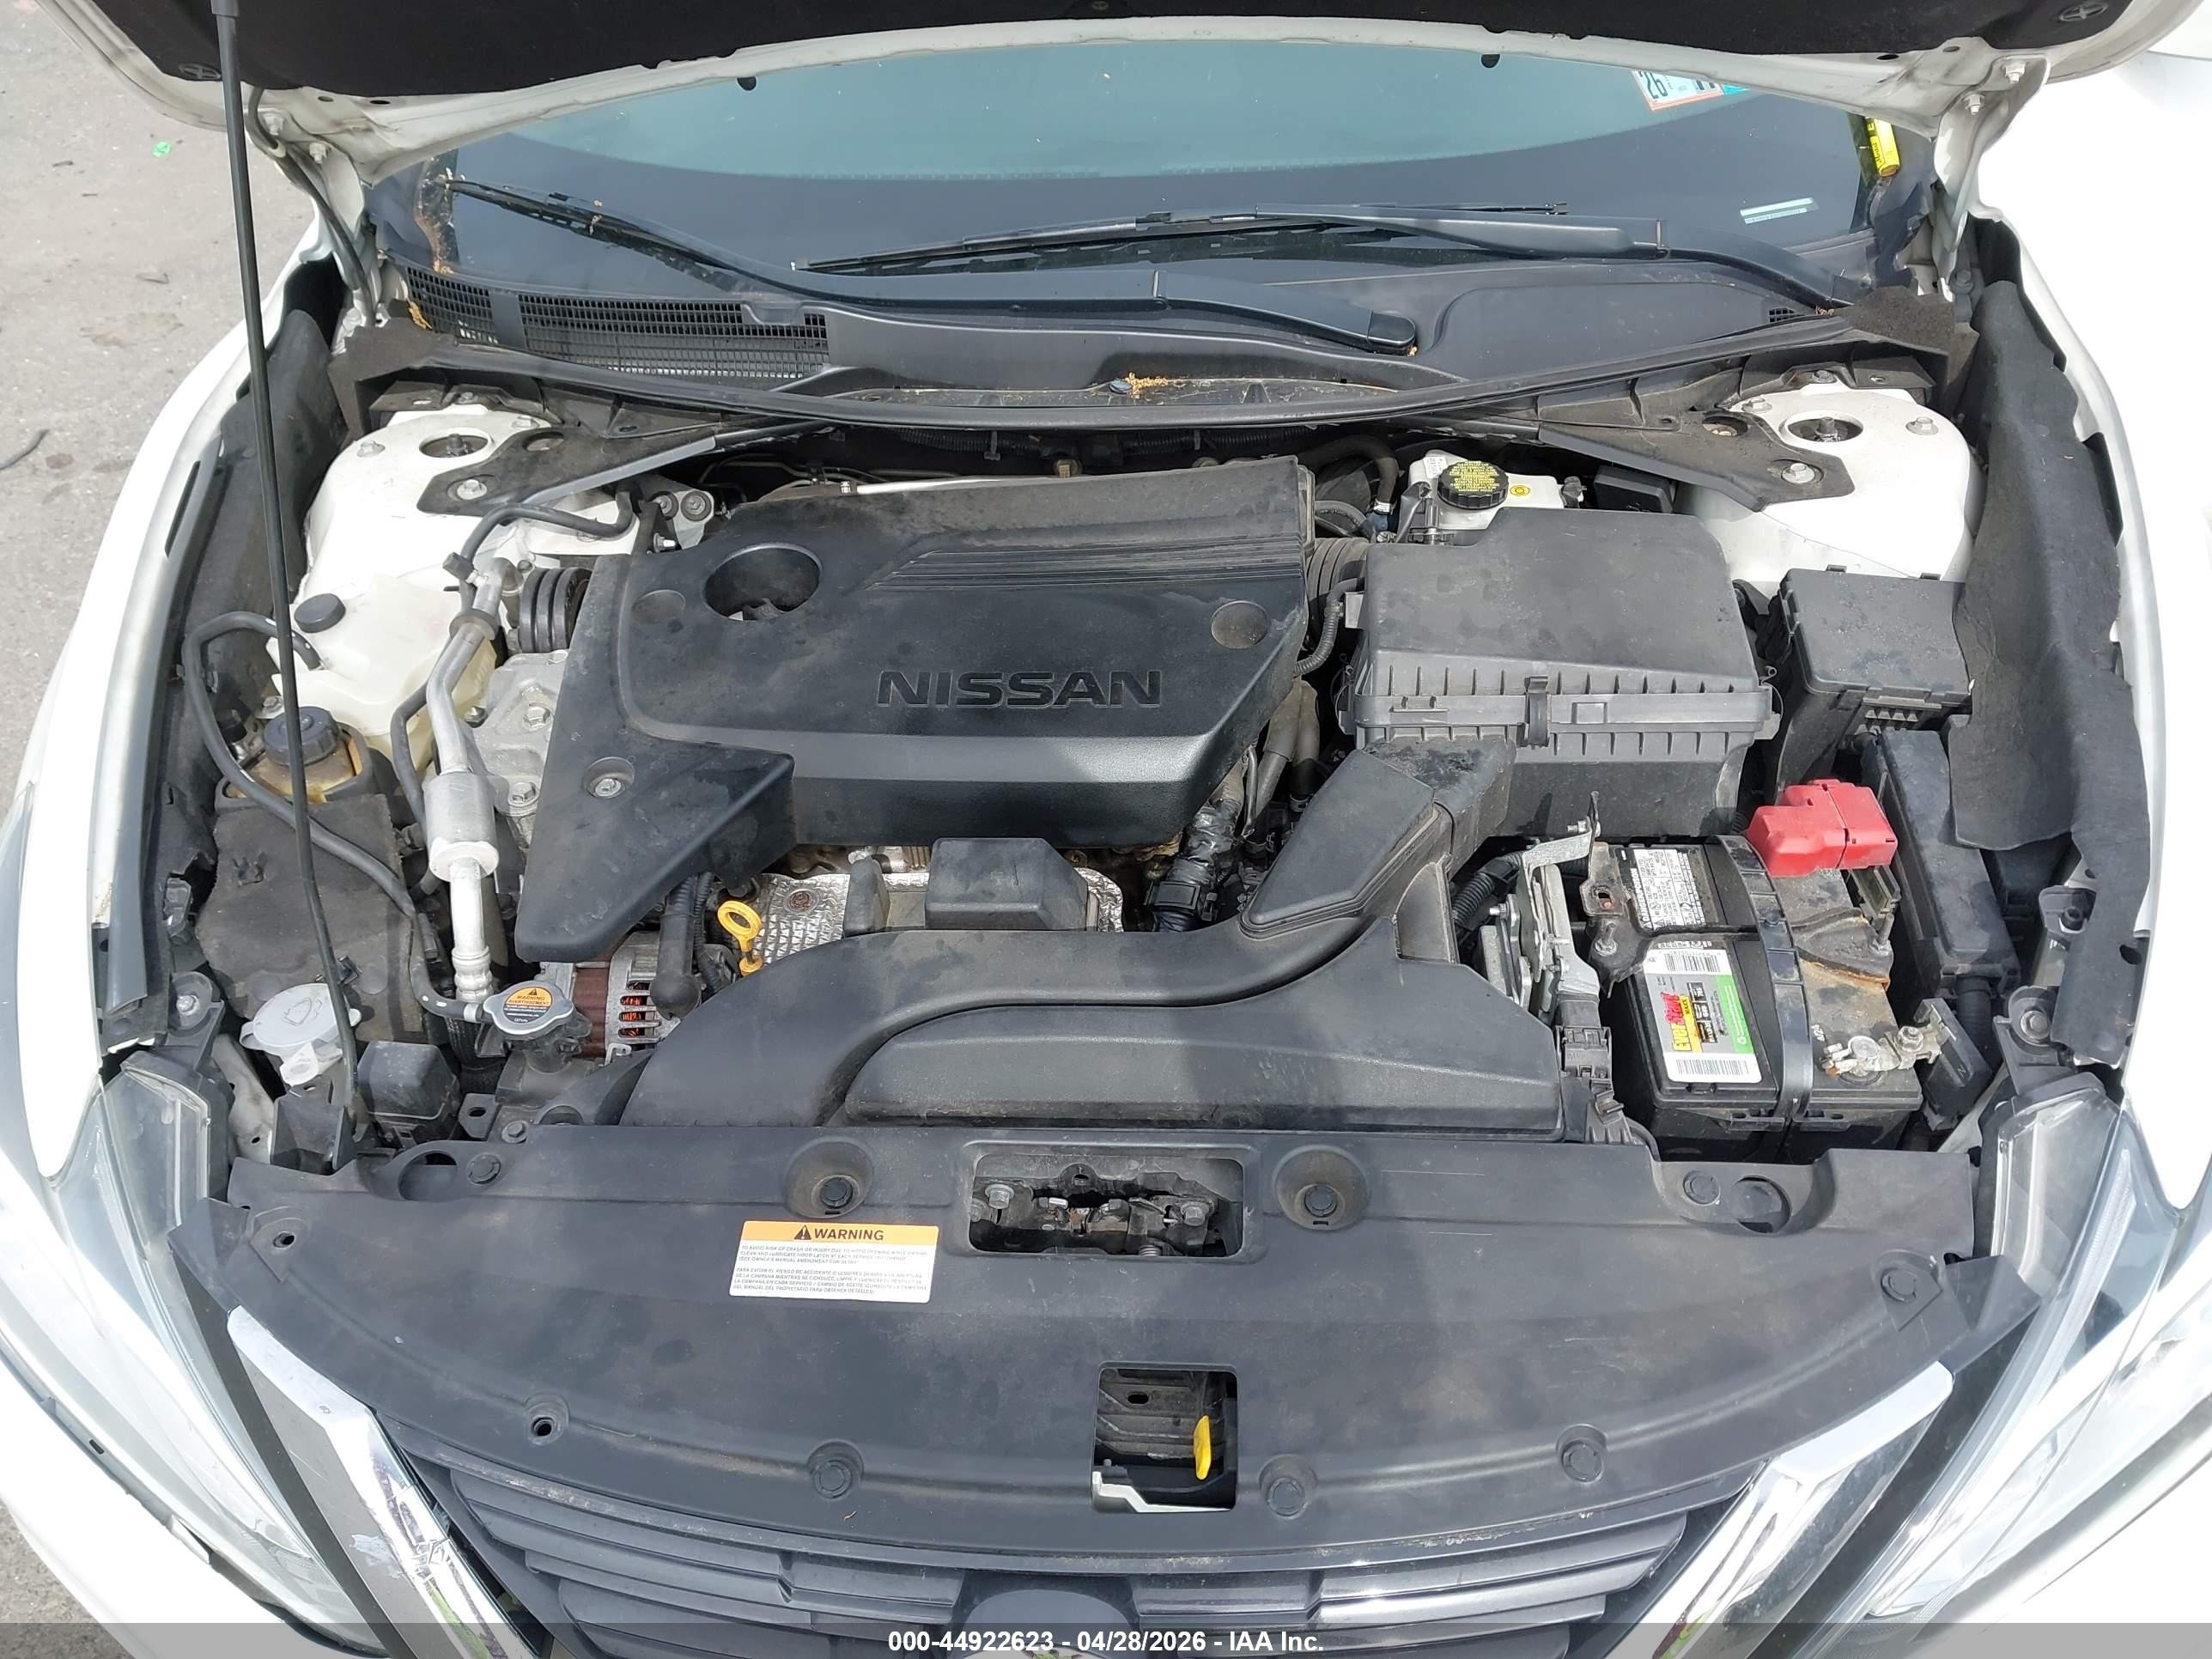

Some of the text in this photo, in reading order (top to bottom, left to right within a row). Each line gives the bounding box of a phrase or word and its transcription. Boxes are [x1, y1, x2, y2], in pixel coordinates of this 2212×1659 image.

[878, 670, 1162, 708] NISSAN
[1658, 992, 1692, 1050] EverStart
[814, 1228, 884, 1241] WARNING
